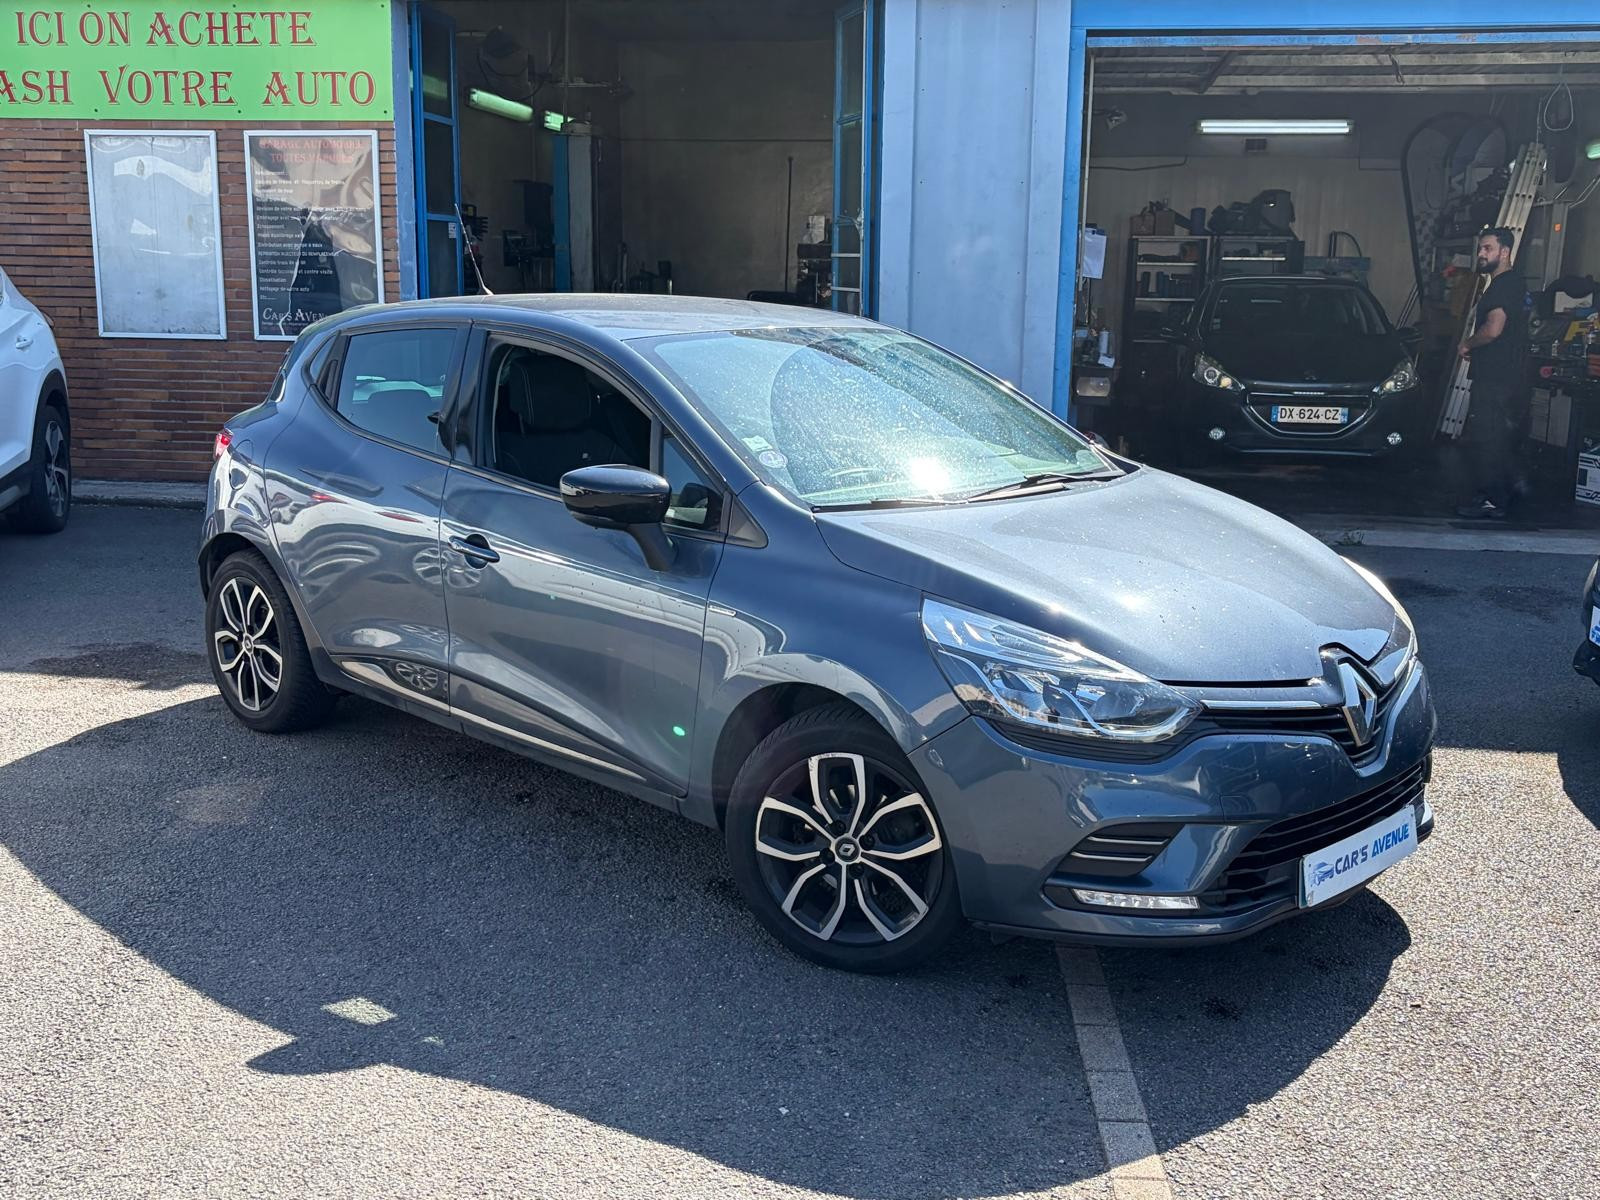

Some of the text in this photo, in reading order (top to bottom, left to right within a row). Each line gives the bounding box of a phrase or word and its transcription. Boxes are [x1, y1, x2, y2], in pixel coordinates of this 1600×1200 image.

[15, 11, 317, 47] ICI ON ACHETE
[98, 64, 238, 108] VOTRE
[262, 70, 377, 107] AUTO
[1335, 822, 1410, 875] CAR'S AVENUE
